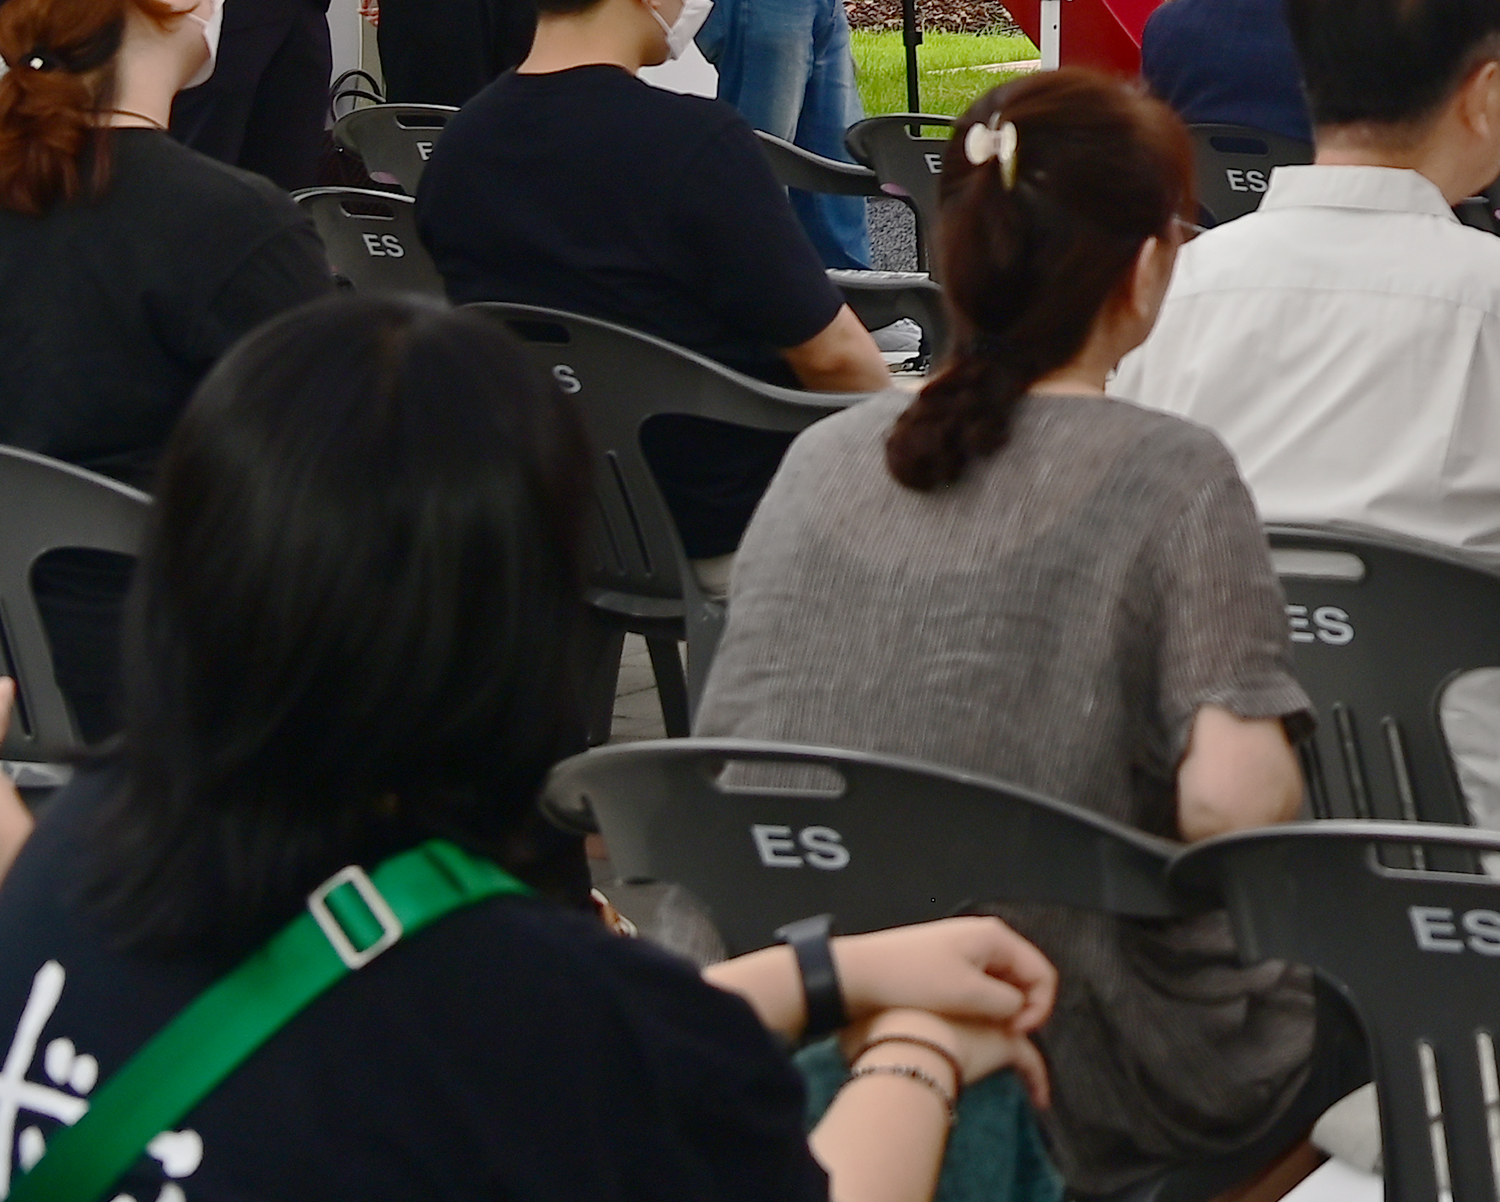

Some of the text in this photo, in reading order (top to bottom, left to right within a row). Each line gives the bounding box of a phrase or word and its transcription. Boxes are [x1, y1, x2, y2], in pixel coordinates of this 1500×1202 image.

[1227, 169, 1267, 192] ES
[362, 233, 405, 257] ES
[552, 364, 582, 394] S
[751, 824, 851, 870] ES
